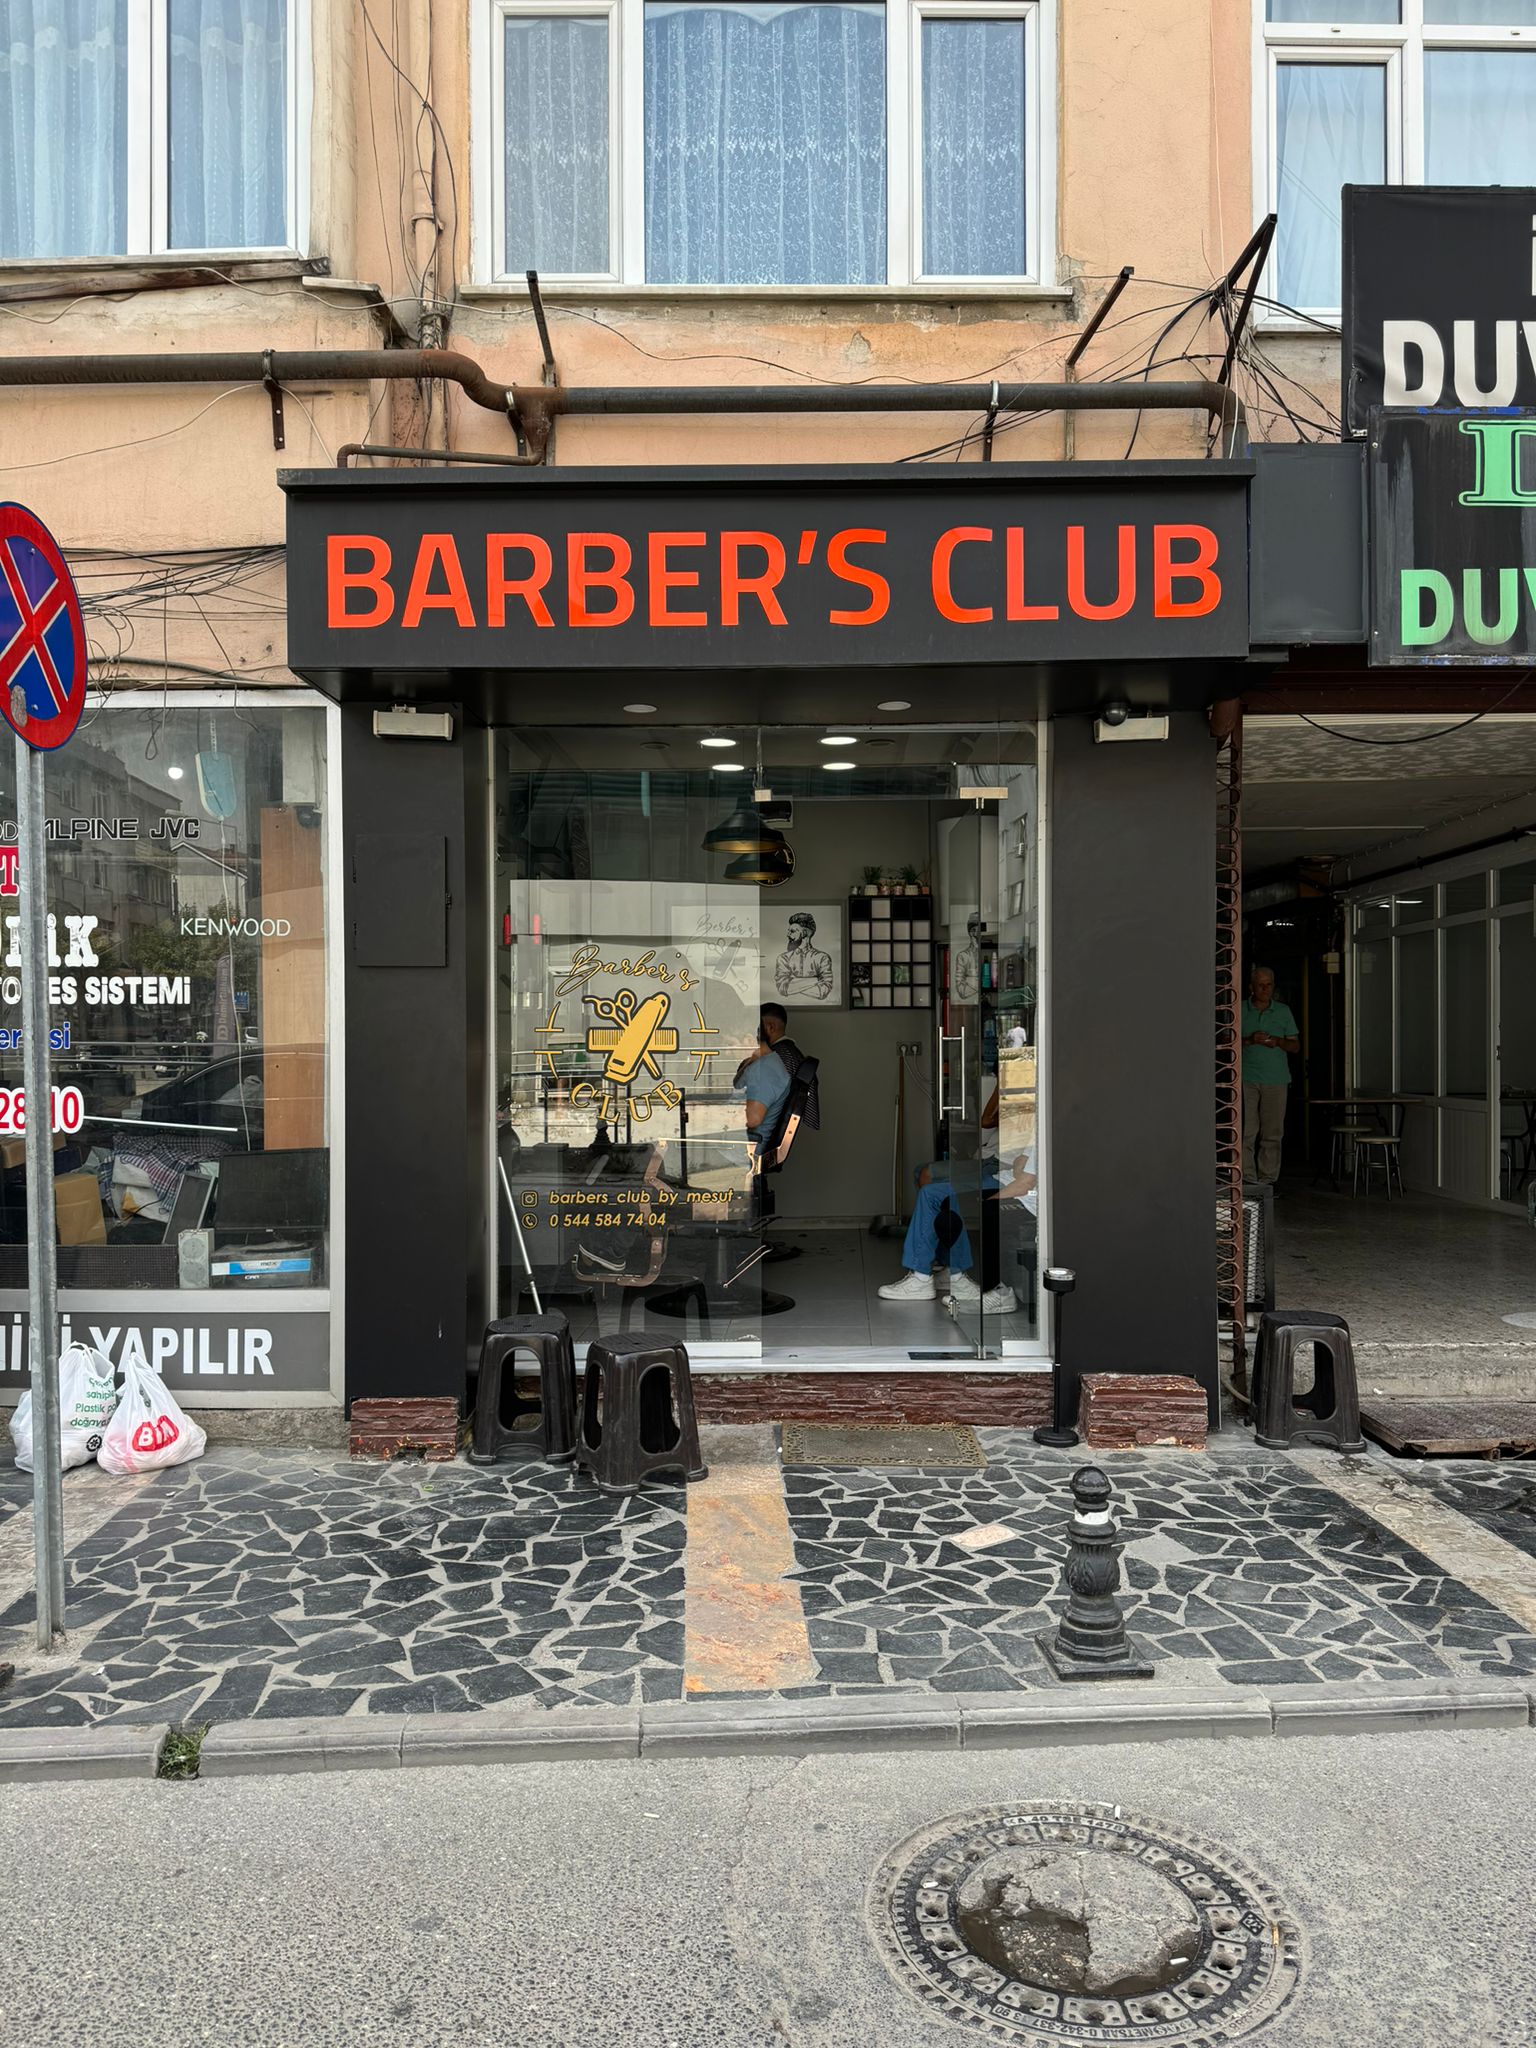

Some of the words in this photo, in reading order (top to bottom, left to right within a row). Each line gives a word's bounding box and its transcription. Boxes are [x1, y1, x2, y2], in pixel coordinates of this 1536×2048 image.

[327, 528, 892, 629] BARBER'S
[931, 523, 1223, 623] CLUB
[150, 818, 200, 839] JVC
[180, 918, 292, 937] KENWOOD
[570, 1079, 686, 1124] CLUB
[550, 1214, 559, 1227] 0
[563, 1213, 590, 1227] 544
[594, 1213, 621, 1227] 584
[625, 1213, 643, 1227] 74
[648, 1213, 666, 1227] 04
[88, 1326, 275, 1376] YAPILIR
